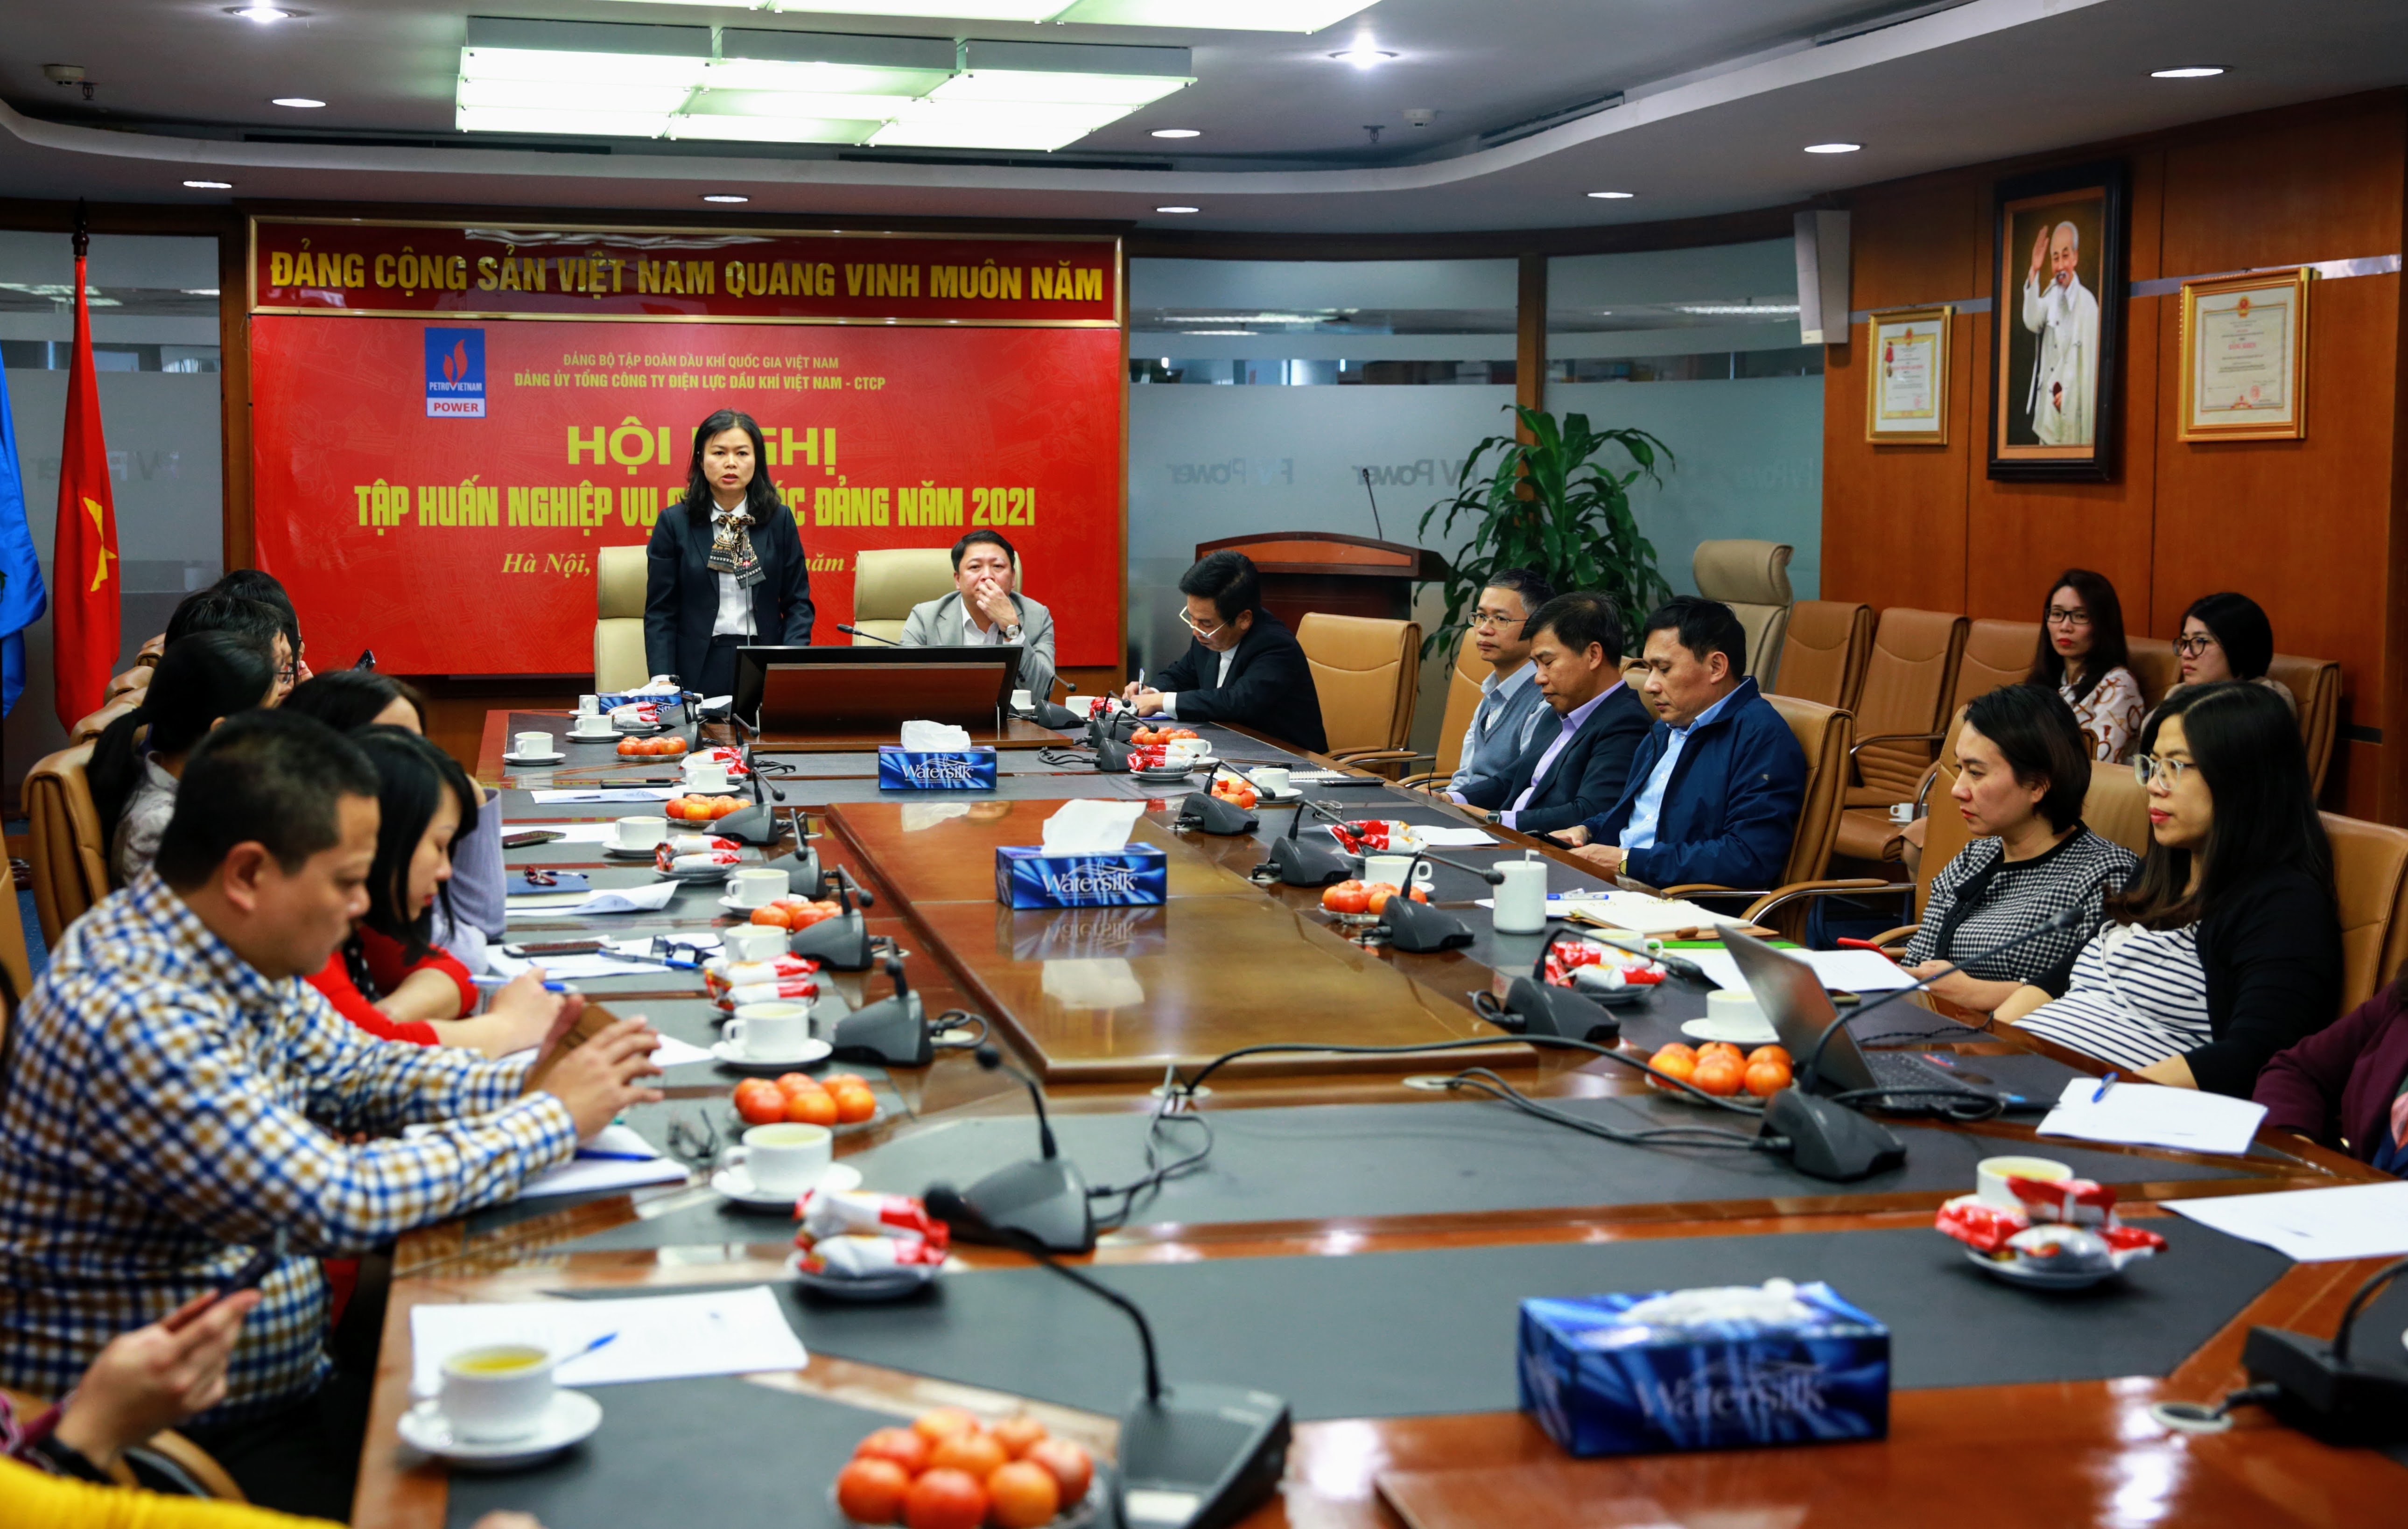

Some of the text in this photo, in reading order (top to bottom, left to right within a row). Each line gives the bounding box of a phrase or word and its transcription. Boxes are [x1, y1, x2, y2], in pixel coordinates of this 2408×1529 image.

[270, 238, 1103, 301] ĐẢNG CỘNG SẢN VIỆT NAM QUANG VINH MUÔN NĂM
[563, 351, 839, 371] ĐẢNG BỘ TẬP ĐOÀN DẦU KHÍ QUỐC GIA VIỆT NAM
[429, 382, 483, 392] PETROVIETNAM
[514, 369, 550, 386] ĐẢNG
[554, 369, 570, 387] ỦY
[574, 369, 608, 387] TỔNG
[612, 372, 647, 388] CÔNG
[651, 375, 665, 387] TY
[669, 372, 699, 391] ĐIỆN
[702, 374, 726, 391] LỰC
[759, 373, 780, 389] KHÍ
[783, 374, 810, 392] VIỆT
[813, 377, 842, 390] NAM
[855, 377, 886, 390] CTCP
[434, 402, 479, 413] POWER
[568, 416, 836, 476] HỘI HỊ
[354, 478, 410, 535] TẬP
[418, 475, 499, 526] HUẤN
[508, 479, 612, 536] NGHIỆP
[620, 487, 658, 536] VỤ
[814, 476, 890, 526] ĐẢNG
[899, 481, 963, 526] NĂM
[972, 487, 1035, 526] 2021
[501, 553, 537, 573] Hà
[543, 553, 590, 578] Nội,
[900, 764, 972, 779] Watersilk
[1041, 871, 1136, 894] Watersilk
